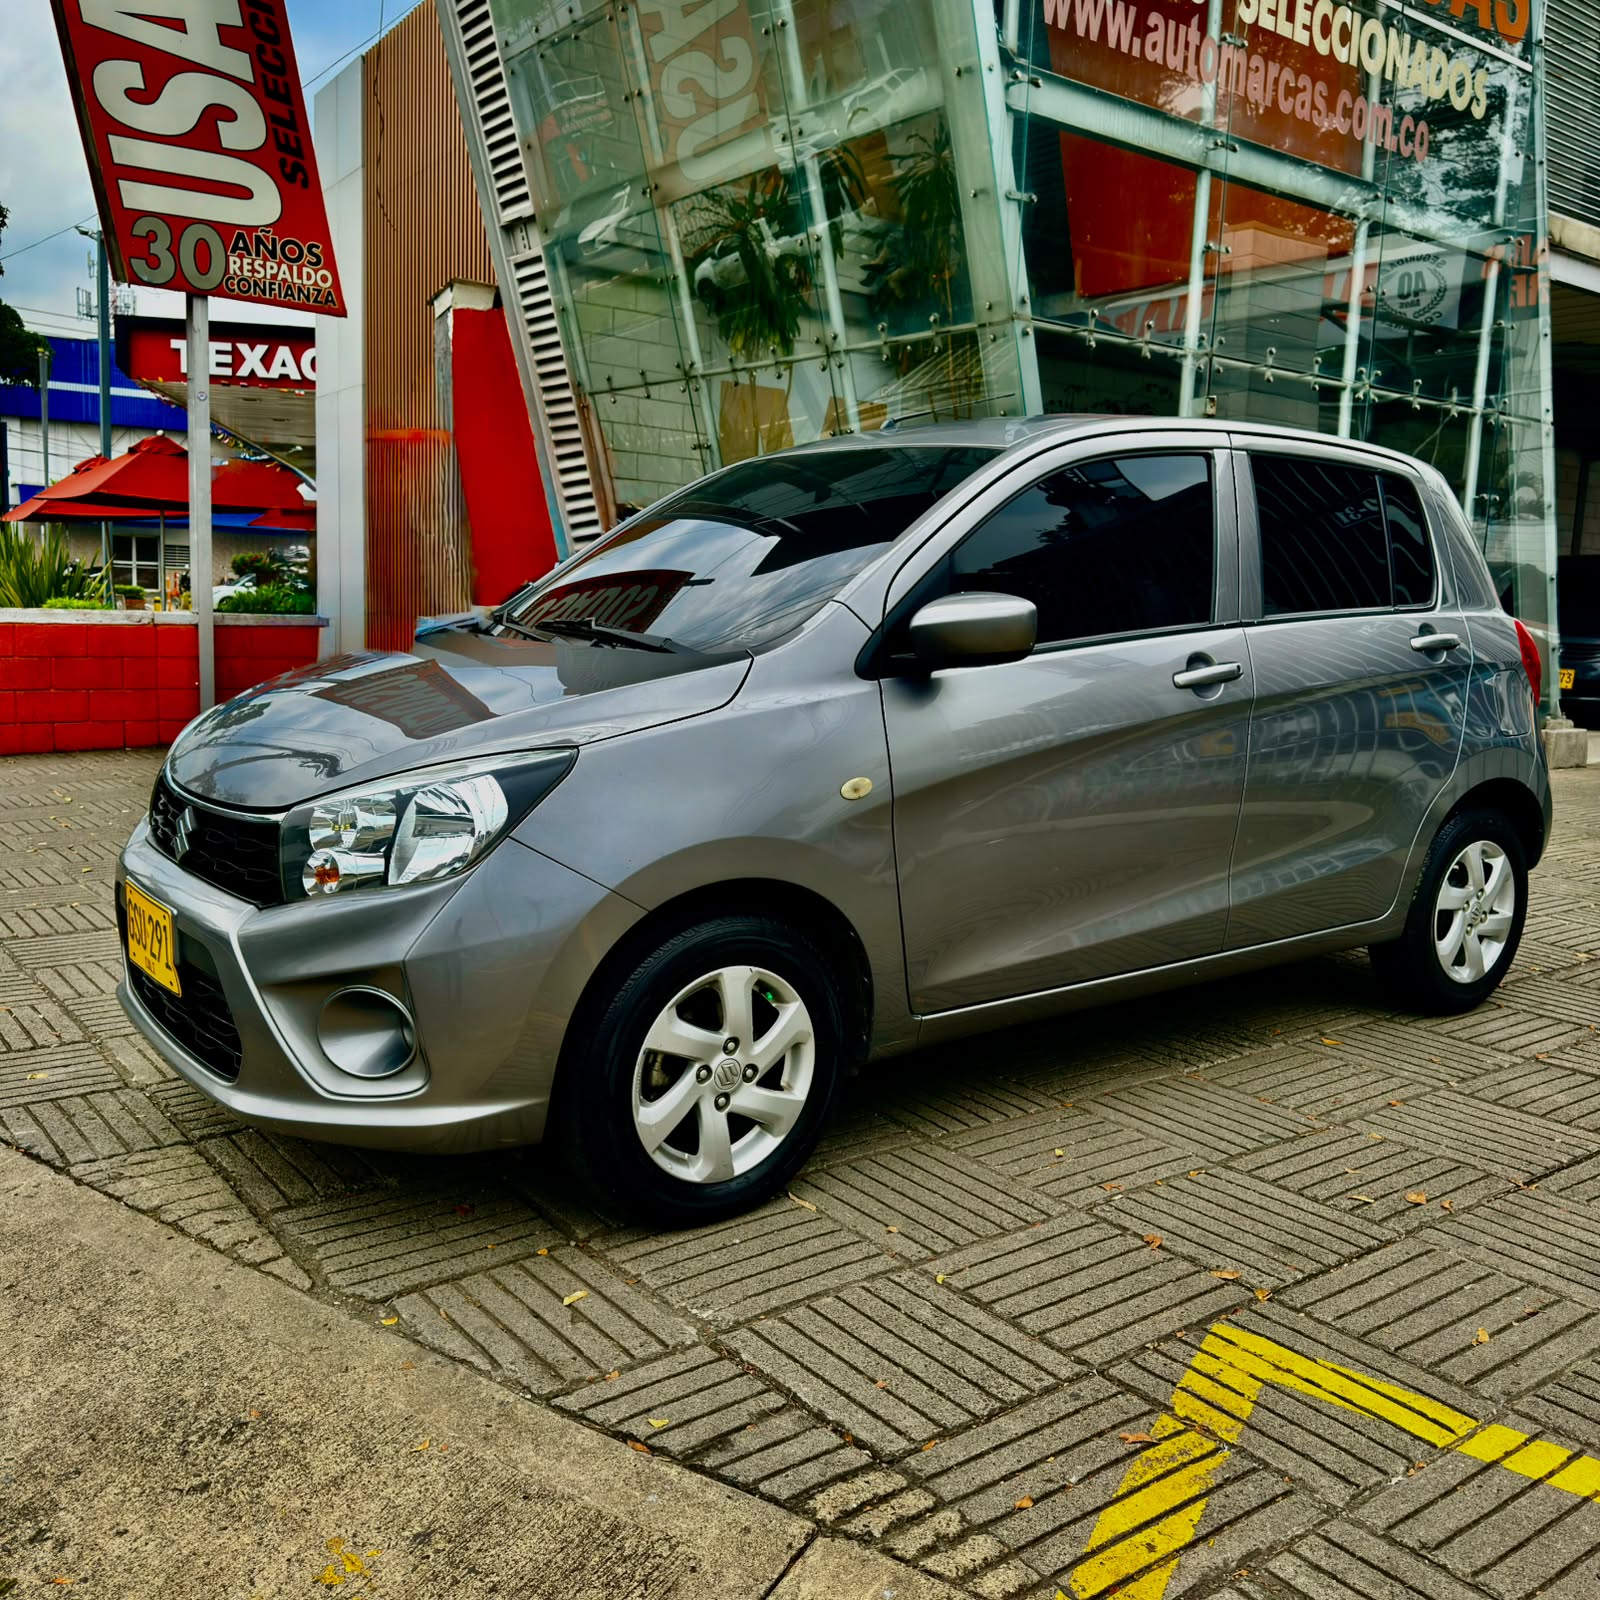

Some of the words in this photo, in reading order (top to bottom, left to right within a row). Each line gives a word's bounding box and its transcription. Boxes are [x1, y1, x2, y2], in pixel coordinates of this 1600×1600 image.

[78, 0, 283, 226] USA
[1043, 0, 1429, 163] www.automarcas.com.co
[128, 216, 228, 291] 30
[228, 227, 324, 268] AÑOS
[223, 274, 338, 307] CONFIANZA
[229, 256, 333, 289] RESPALDO
